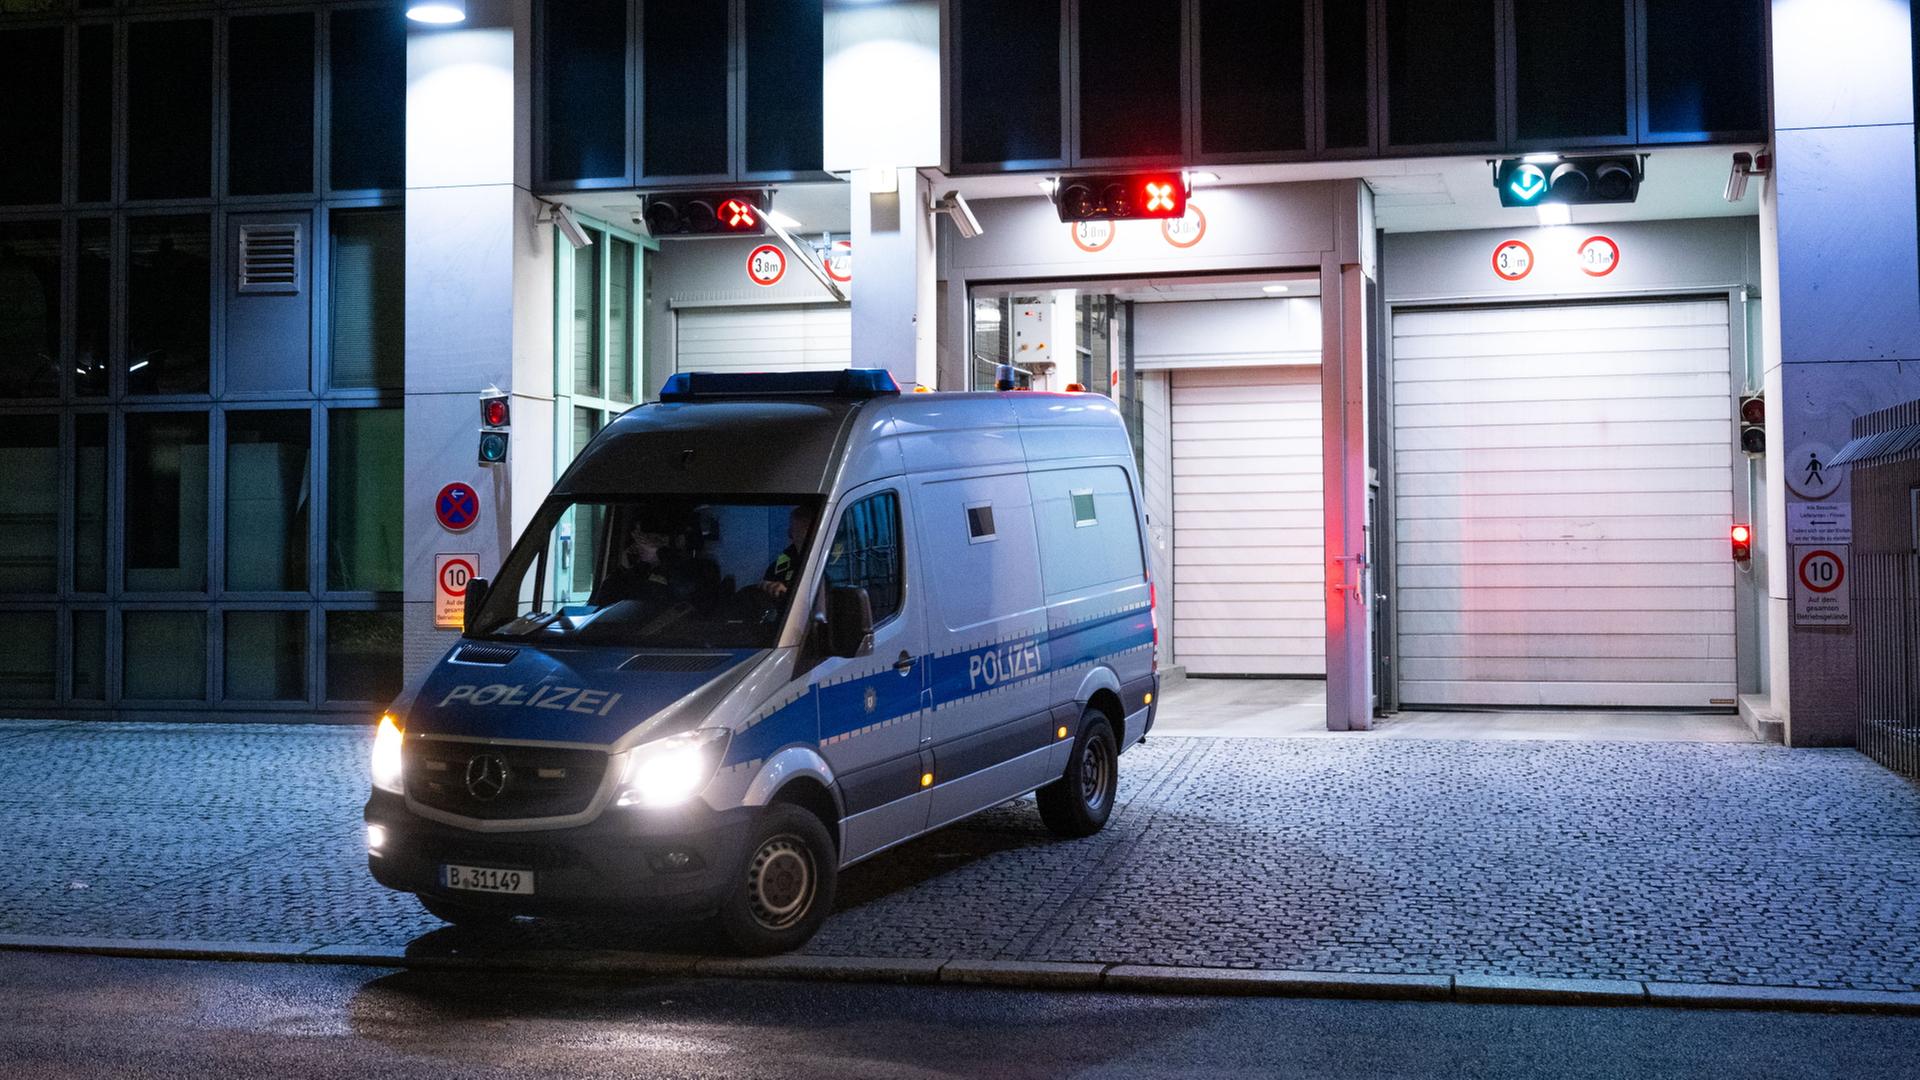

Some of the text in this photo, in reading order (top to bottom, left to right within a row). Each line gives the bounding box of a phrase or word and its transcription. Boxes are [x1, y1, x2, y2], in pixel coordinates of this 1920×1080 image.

[448, 569, 466, 587] 10
[1811, 562, 1833, 582] 10
[969, 639, 1041, 690] POLIZEI
[437, 683, 623, 717] POLIZEI
